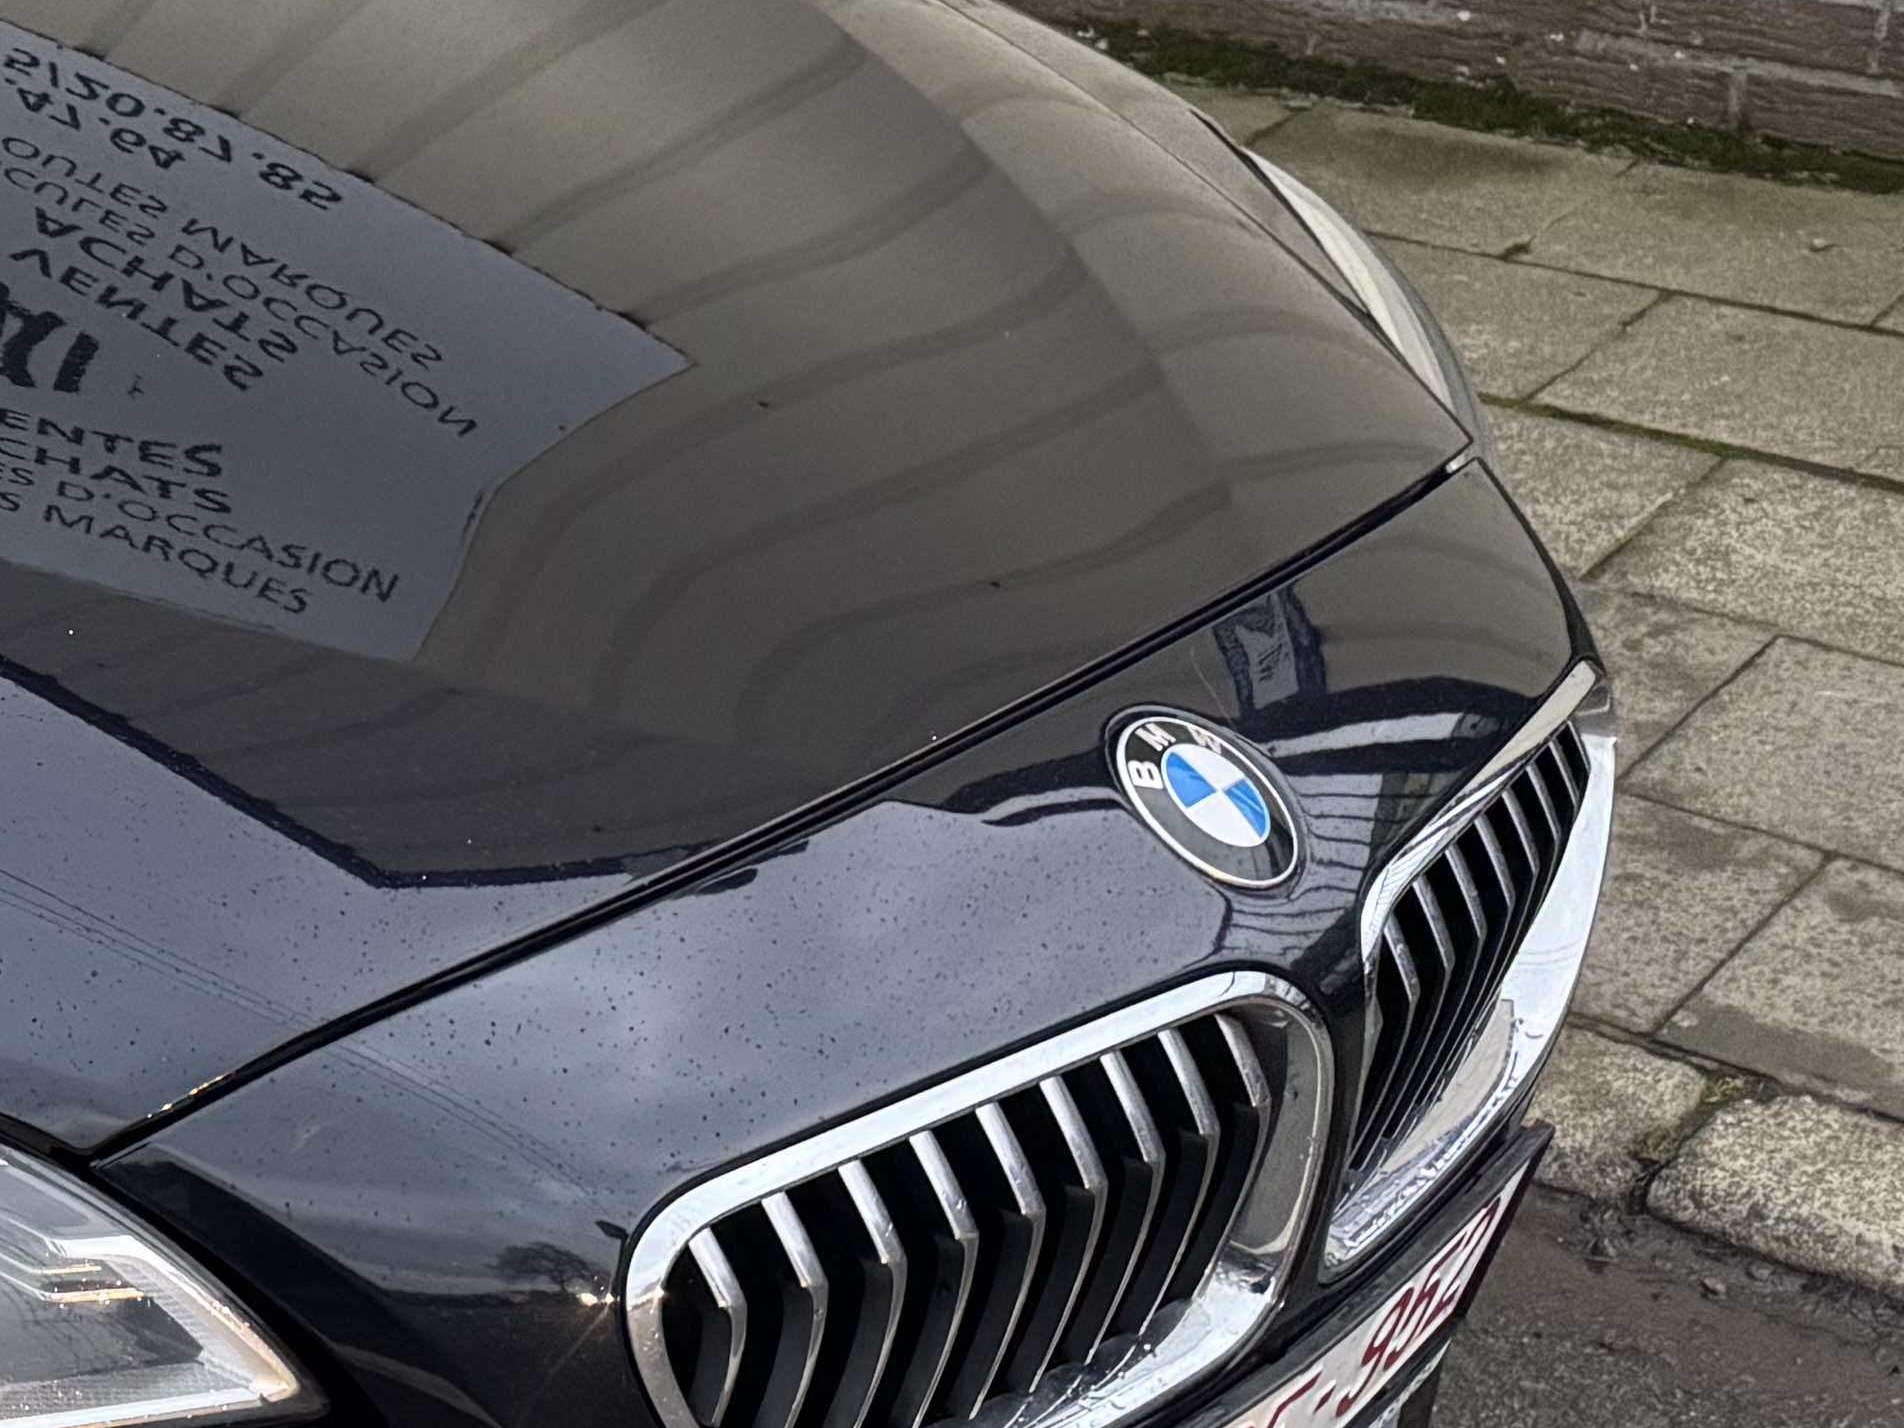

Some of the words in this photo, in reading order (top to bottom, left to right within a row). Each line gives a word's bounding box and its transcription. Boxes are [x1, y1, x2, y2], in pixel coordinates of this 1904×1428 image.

[43, 504, 310, 615] MARQUES
[57, 480, 399, 602] D'OCCASION
[1127, 722, 1223, 791] BMW
